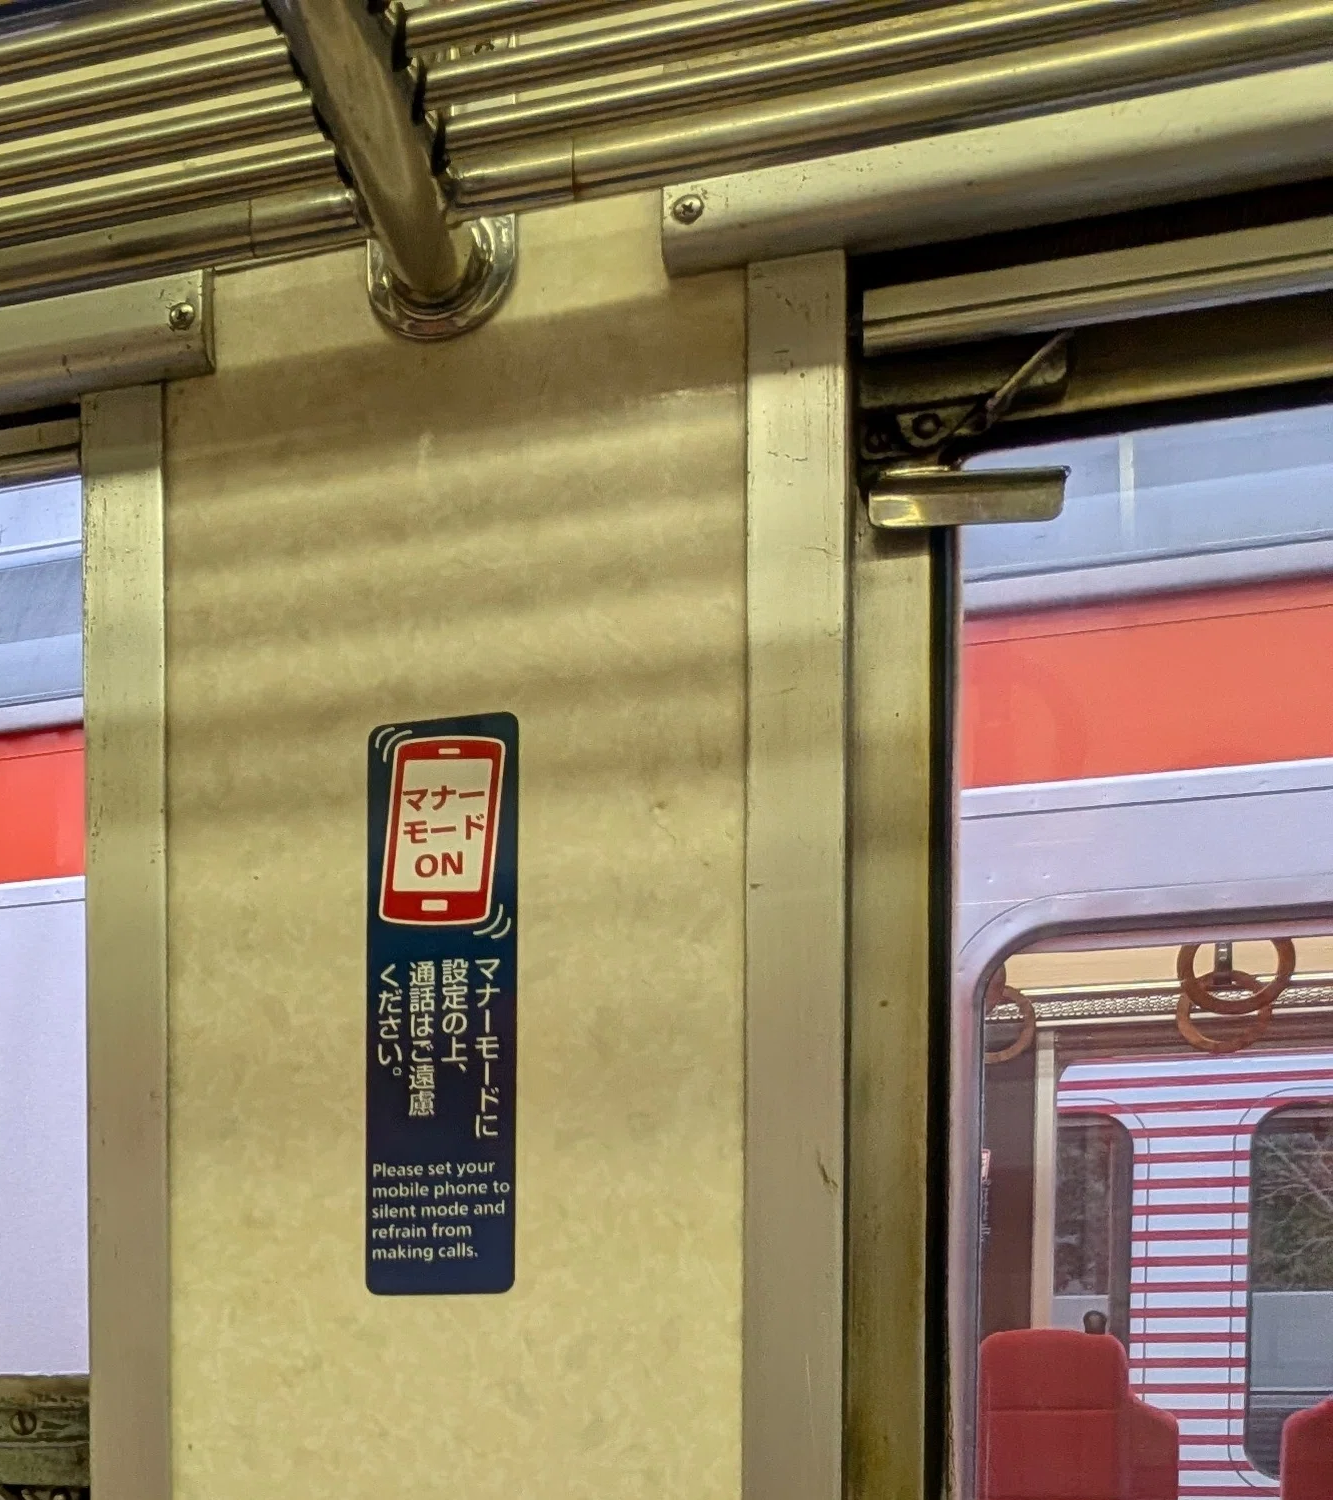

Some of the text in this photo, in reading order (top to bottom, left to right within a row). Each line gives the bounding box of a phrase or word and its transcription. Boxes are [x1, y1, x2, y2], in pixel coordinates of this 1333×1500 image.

[403, 785, 485, 811] マナー
[403, 814, 484, 844] モード
[415, 851, 463, 878] ON
[378, 963, 402, 1076] ください。
[441, 958, 469, 1072] 設定の上、
[408, 961, 436, 1116] 通話はご遠慮
[474, 958, 501, 1139] マナーモードに
[373, 1161, 495, 1177] Please set your
[373, 1180, 510, 1199] mobile phone to
[372, 1199, 505, 1218] silent mode and
[372, 1222, 472, 1239] refrain from
[372, 1244, 434, 1261] making
